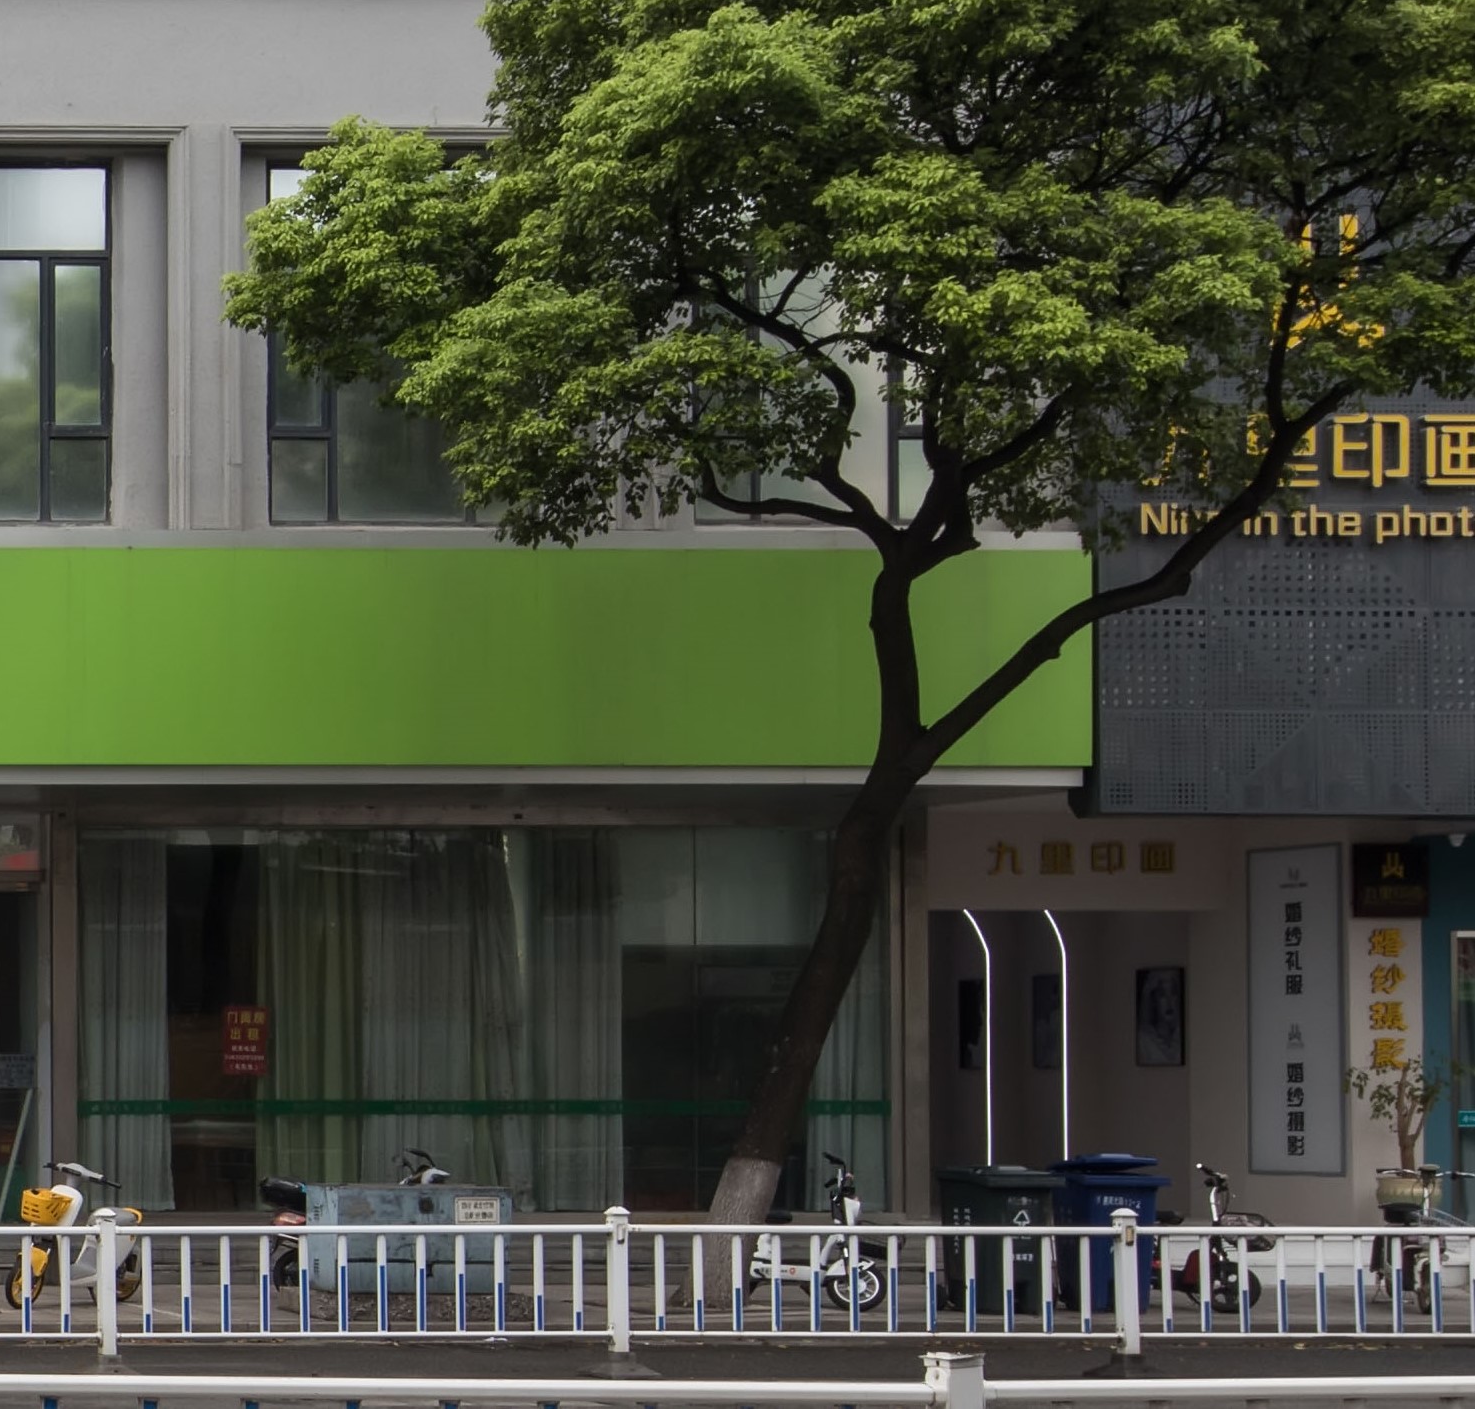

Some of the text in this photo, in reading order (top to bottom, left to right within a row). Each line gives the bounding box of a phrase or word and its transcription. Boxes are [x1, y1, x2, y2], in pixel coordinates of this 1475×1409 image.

[1291, 503, 1362, 537] the
[987, 840, 1176, 875] 九里印画
[1284, 901, 1303, 995] 婚纱礼服
[1286, 1062, 1305, 1157] 婚纱摄影
